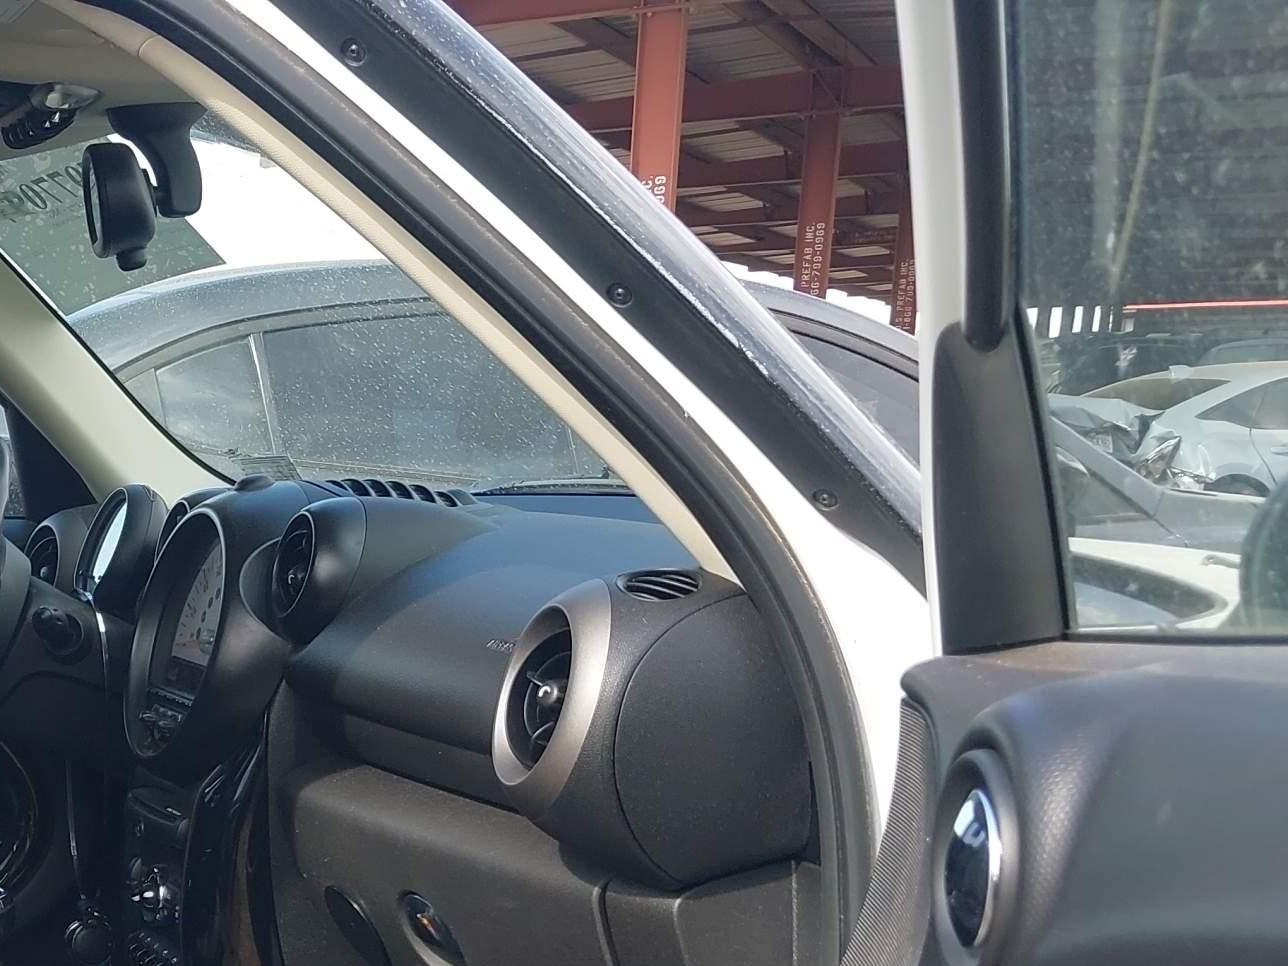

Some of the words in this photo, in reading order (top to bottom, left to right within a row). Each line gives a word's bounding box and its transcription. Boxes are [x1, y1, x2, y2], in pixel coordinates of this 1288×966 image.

[804, 222, 816, 242] INC.
[800, 247, 813, 288] PREFAB
[896, 279, 907, 311] PREFAB
